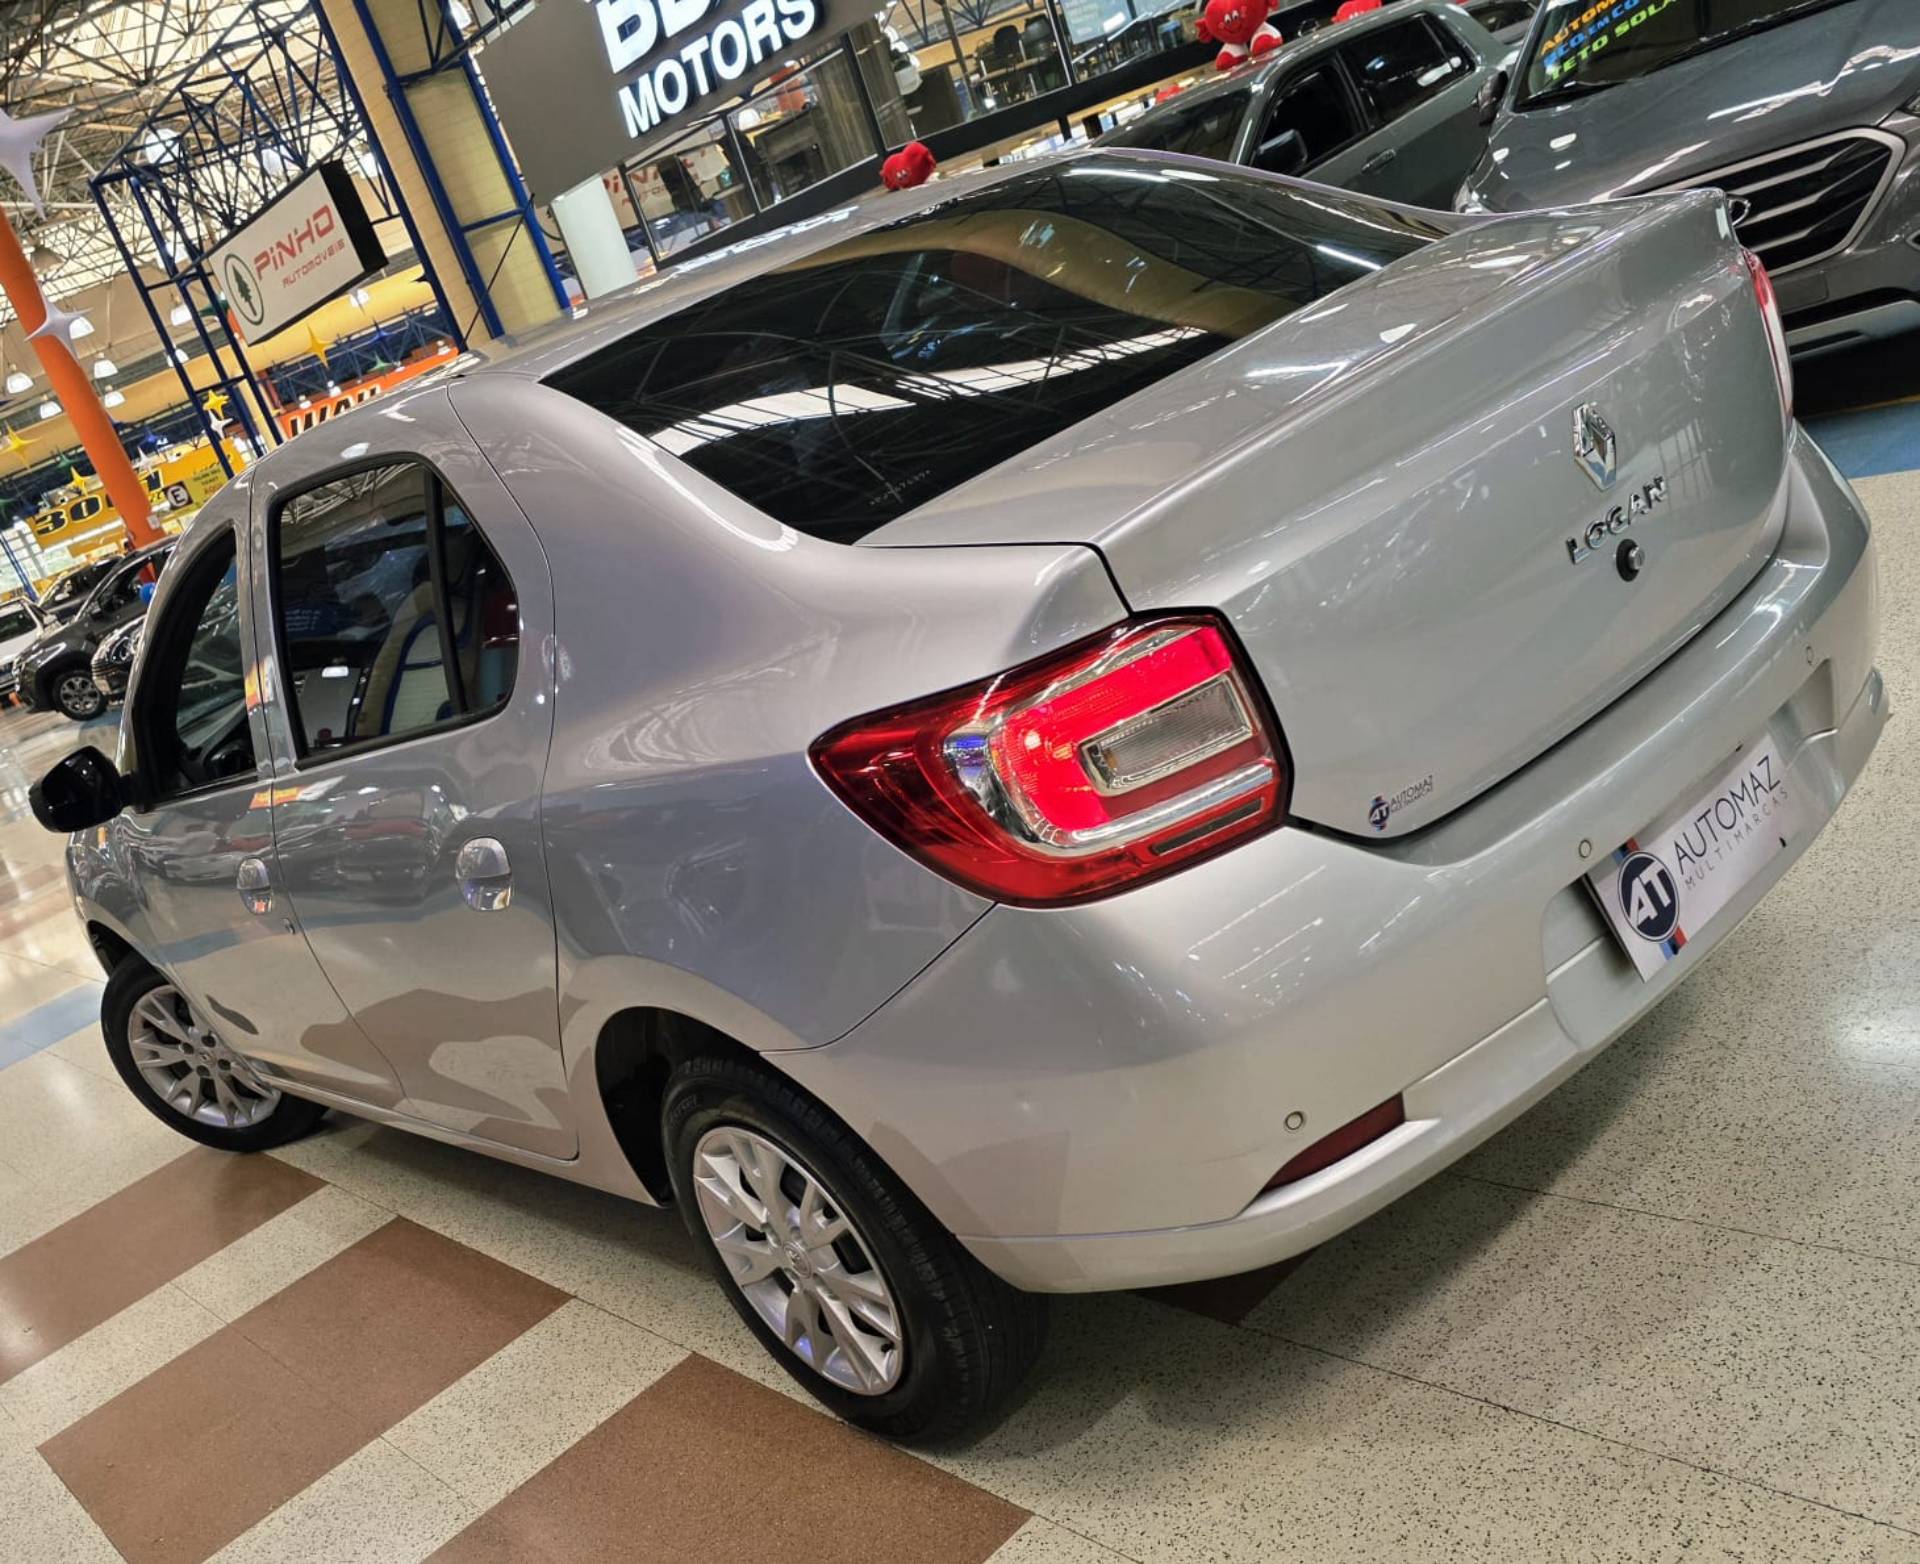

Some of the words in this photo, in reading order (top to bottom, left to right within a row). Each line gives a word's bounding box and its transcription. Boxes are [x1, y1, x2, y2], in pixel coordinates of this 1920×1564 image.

[617, 0, 816, 139] MOTORS
[1551, 34, 1609, 80] TETO
[1566, 476, 1667, 565] LOGAN
[1673, 754, 1782, 876] AUTOMAZ
[1684, 786, 1789, 891] MULTIMARCAS
